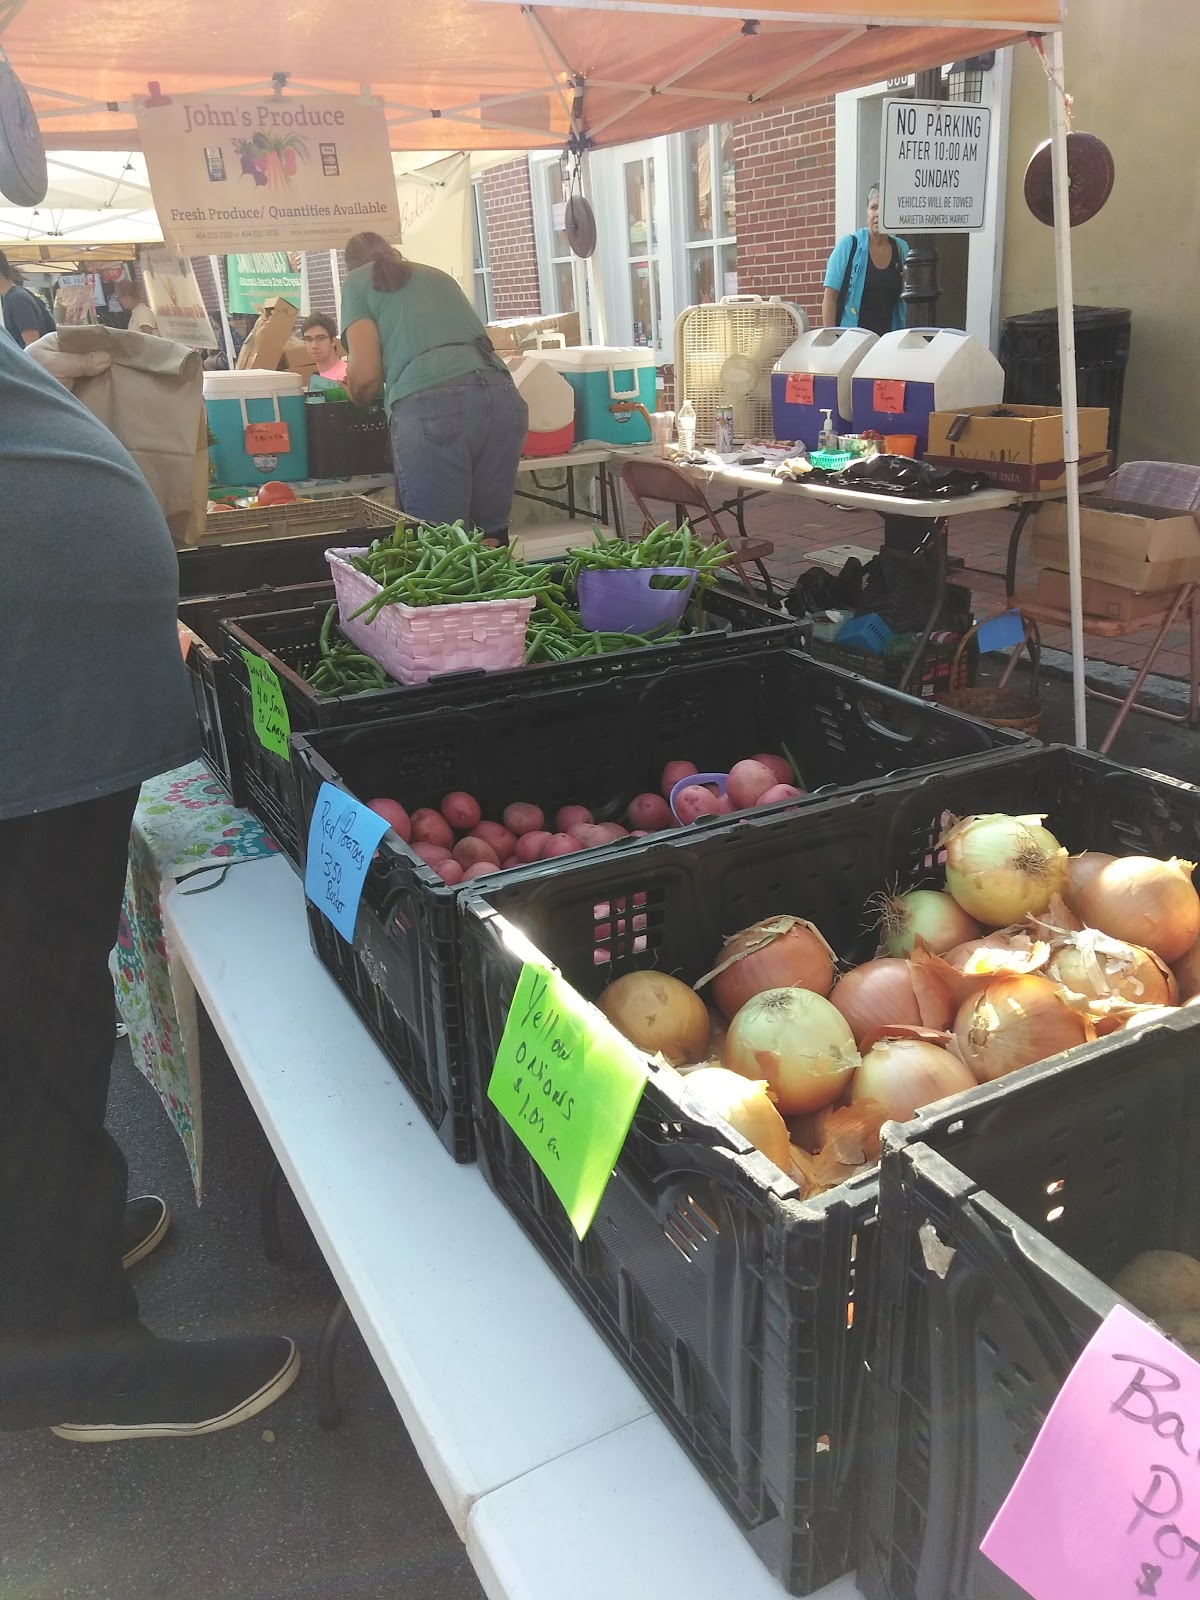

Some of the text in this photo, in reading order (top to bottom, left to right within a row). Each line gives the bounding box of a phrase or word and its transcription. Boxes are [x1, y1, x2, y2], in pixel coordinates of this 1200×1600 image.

[183, 104, 345, 133] John's Produce
[896, 108, 981, 138] NO PARKING
[898, 140, 977, 161] AFTER 10:00 AM
[914, 168, 960, 188] SUNDAYS
[171, 207, 206, 222] Fresh
[269, 204, 331, 219] Quantities
[333, 201, 387, 216] Available
[897, 196, 973, 208] VEHICLES WILL BE TOWED
[899, 214, 969, 225] MARIETTA FARMERS MARKET
[282, 276, 301, 287] Crea
[320, 800, 342, 840] Red
[520, 973, 574, 1061] Yellow
[1108, 1352, 1192, 1457] Ba
